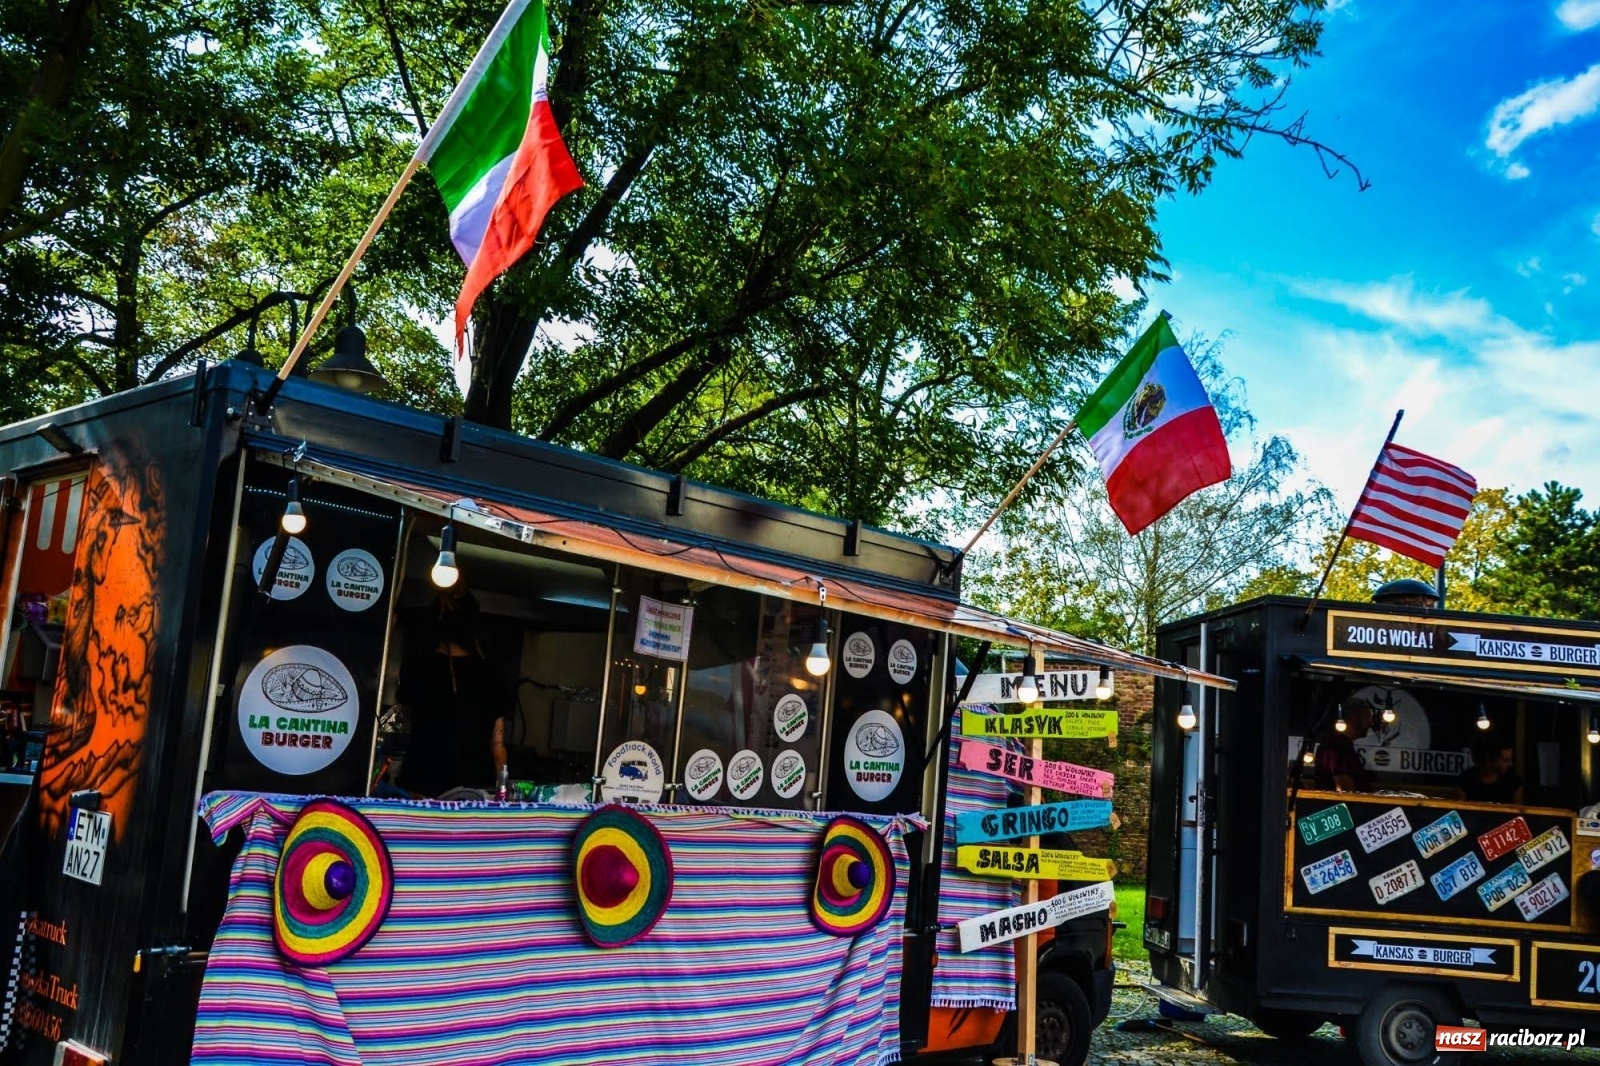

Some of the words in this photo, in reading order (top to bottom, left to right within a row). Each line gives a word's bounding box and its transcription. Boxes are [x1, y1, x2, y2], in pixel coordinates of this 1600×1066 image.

[273, 579, 301, 589] RGER
[277, 571, 309, 583] ANTINA
[337, 589, 371, 600] BURGER
[344, 583, 378, 594] CANTINA
[1347, 626, 1375, 644] 200
[1377, 629, 1387, 645] G
[1479, 640, 1526, 658] KANSAS
[1550, 646, 1597, 664] BURGER
[1001, 673, 1088, 699] MENU
[249, 715, 269, 730] LA
[276, 716, 348, 734] CANTINA
[785, 719, 804, 737] BURGER
[786, 711, 806, 728] CANTINA
[261, 731, 333, 749] BURGER
[850, 760, 861, 770] LA
[864, 761, 900, 772] CANTINA
[986, 748, 1034, 781] SER
[1044, 761, 1056, 769] 200
[1400, 750, 1465, 775] BURGER
[691, 784, 698, 792] LA
[699, 767, 721, 786] CANTINA
[733, 784, 740, 792] LA
[740, 766, 762, 785] CANTINA
[739, 775, 760, 794] BURGER
[783, 774, 802, 793] BURGER
[784, 766, 804, 784] CANTINA
[856, 772, 892, 783] BURGER
[697, 776, 719, 795] BURGER
[75, 812, 103, 846] ETM
[981, 807, 1069, 837] GRINGO
[1321, 813, 1342, 832] 308
[1367, 814, 1393, 829] KANSAS
[1368, 815, 1407, 844] 534595
[1493, 828, 1519, 849] 1142
[66, 844, 100, 880] AN27
[976, 848, 1040, 873] SALSA
[1522, 848, 1544, 869] BLU
[1544, 836, 1567, 855] 912
[1312, 855, 1339, 871] KANSAS
[1320, 860, 1353, 885] 26458
[1383, 868, 1403, 879] KANSAS
[1437, 875, 1458, 896] 057
[1459, 861, 1479, 882] BIP
[1508, 872, 1528, 892] 023
[1374, 886, 1384, 900] D
[1384, 873, 1409, 895] 2087
[1529, 883, 1561, 909] 90214
[979, 908, 1048, 942] MACHO
[1375, 945, 1414, 960] KANSAS
[1433, 949, 1472, 964] BURGER
